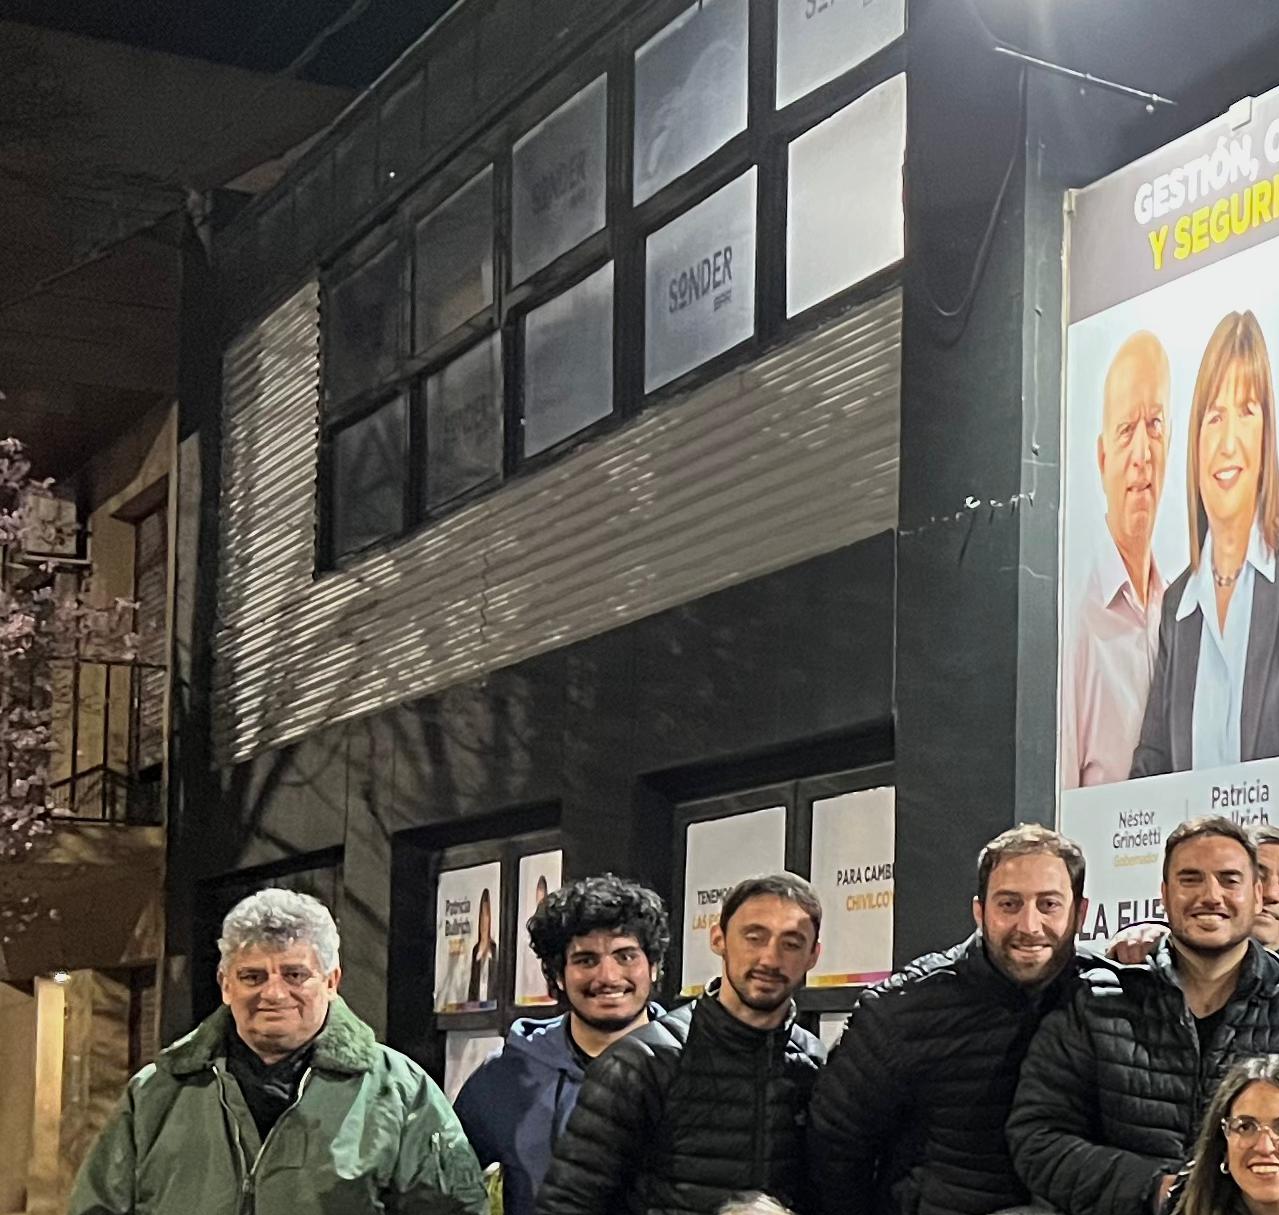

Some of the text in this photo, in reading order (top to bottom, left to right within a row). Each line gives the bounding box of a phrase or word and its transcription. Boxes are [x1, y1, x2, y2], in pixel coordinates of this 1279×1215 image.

[1134, 134, 1259, 225] GESTIÓN,
[1148, 224, 1169, 271] Y
[668, 246, 733, 314] SONDER
[1211, 777, 1270, 810] Patricia
[1112, 825, 1162, 849] Grindetti
[836, 863, 892, 887] PARA CAMB
[846, 890, 893, 911] CHIVILCO
[1118, 899, 1165, 931] FUE
